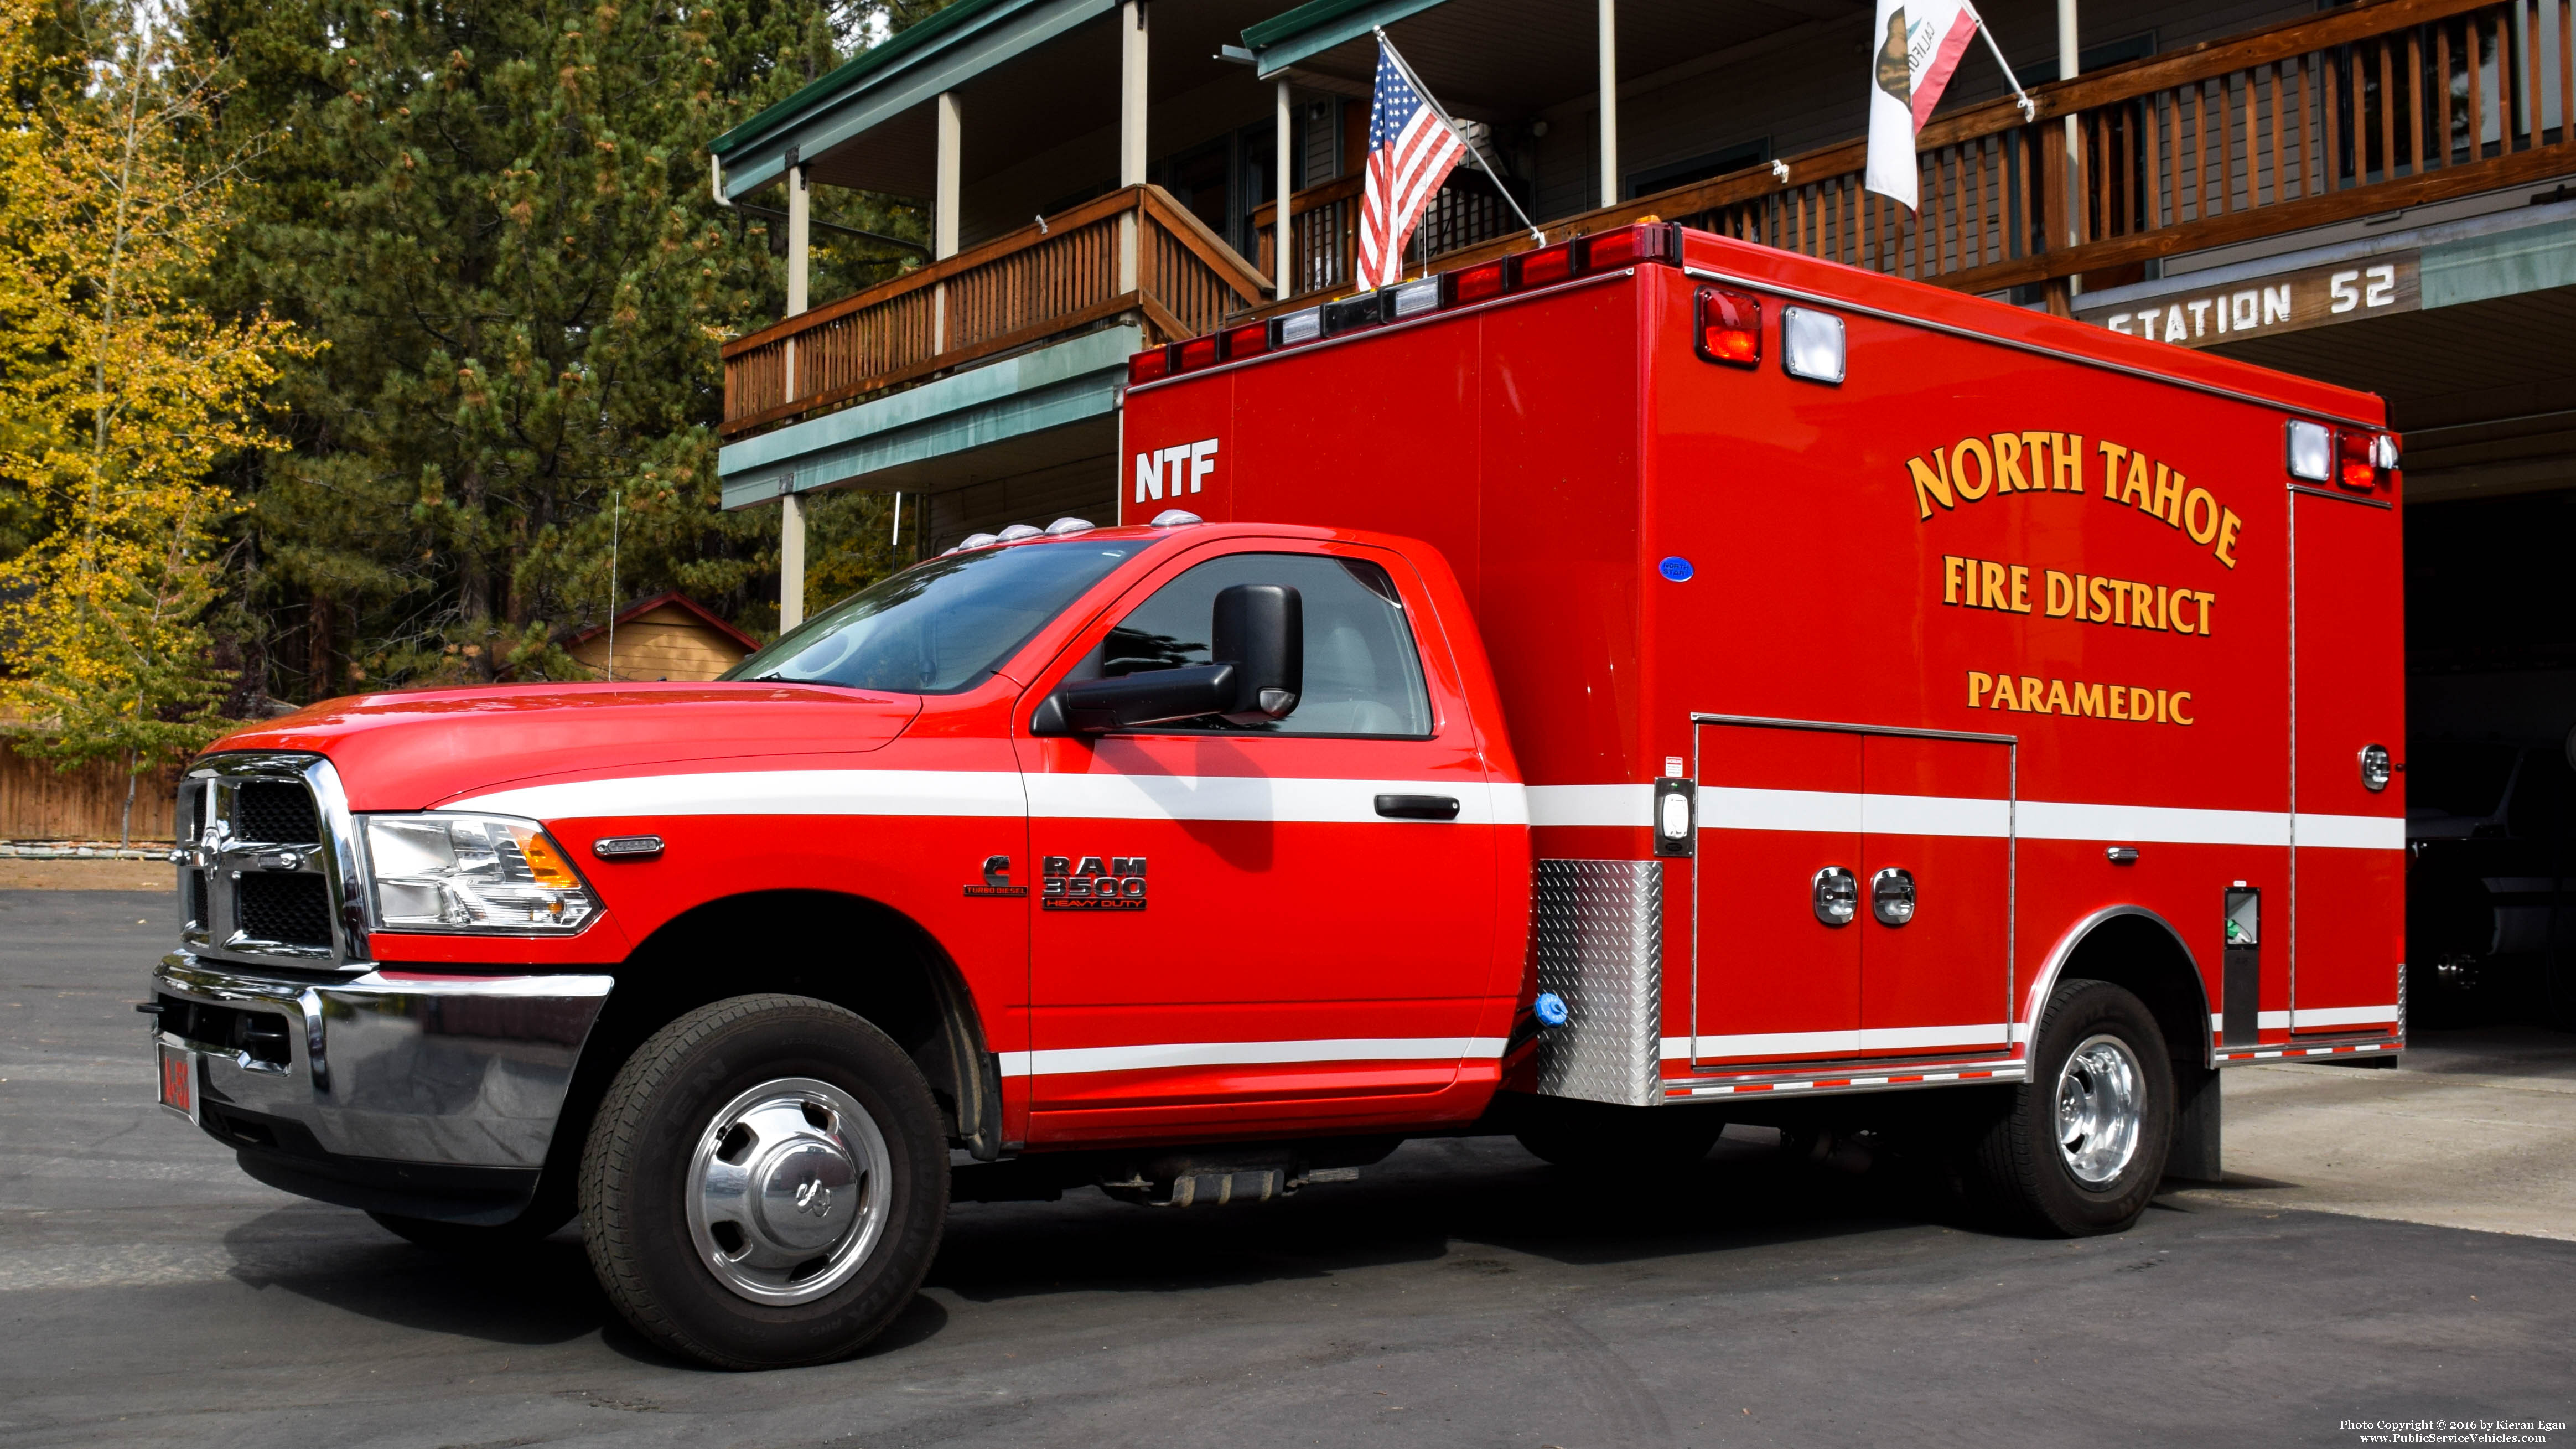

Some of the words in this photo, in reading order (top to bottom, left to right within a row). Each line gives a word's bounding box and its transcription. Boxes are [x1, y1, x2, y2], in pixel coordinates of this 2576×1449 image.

[2331, 263, 2395, 314] 52
[1136, 438, 1219, 504] NTF
[1906, 430, 2085, 521] NORTH
[2098, 439, 2243, 569] TAHOE
[1943, 555, 2033, 614] FIRE
[2045, 569, 2215, 636] DISTRICT
[1967, 670, 2194, 726] PARAMEDIC
[1042, 856, 1147, 876] RAM
[1043, 876, 1147, 897] 3500
[1046, 899, 1097, 908] HEAVY
[1101, 899, 1144, 908] DUTY
